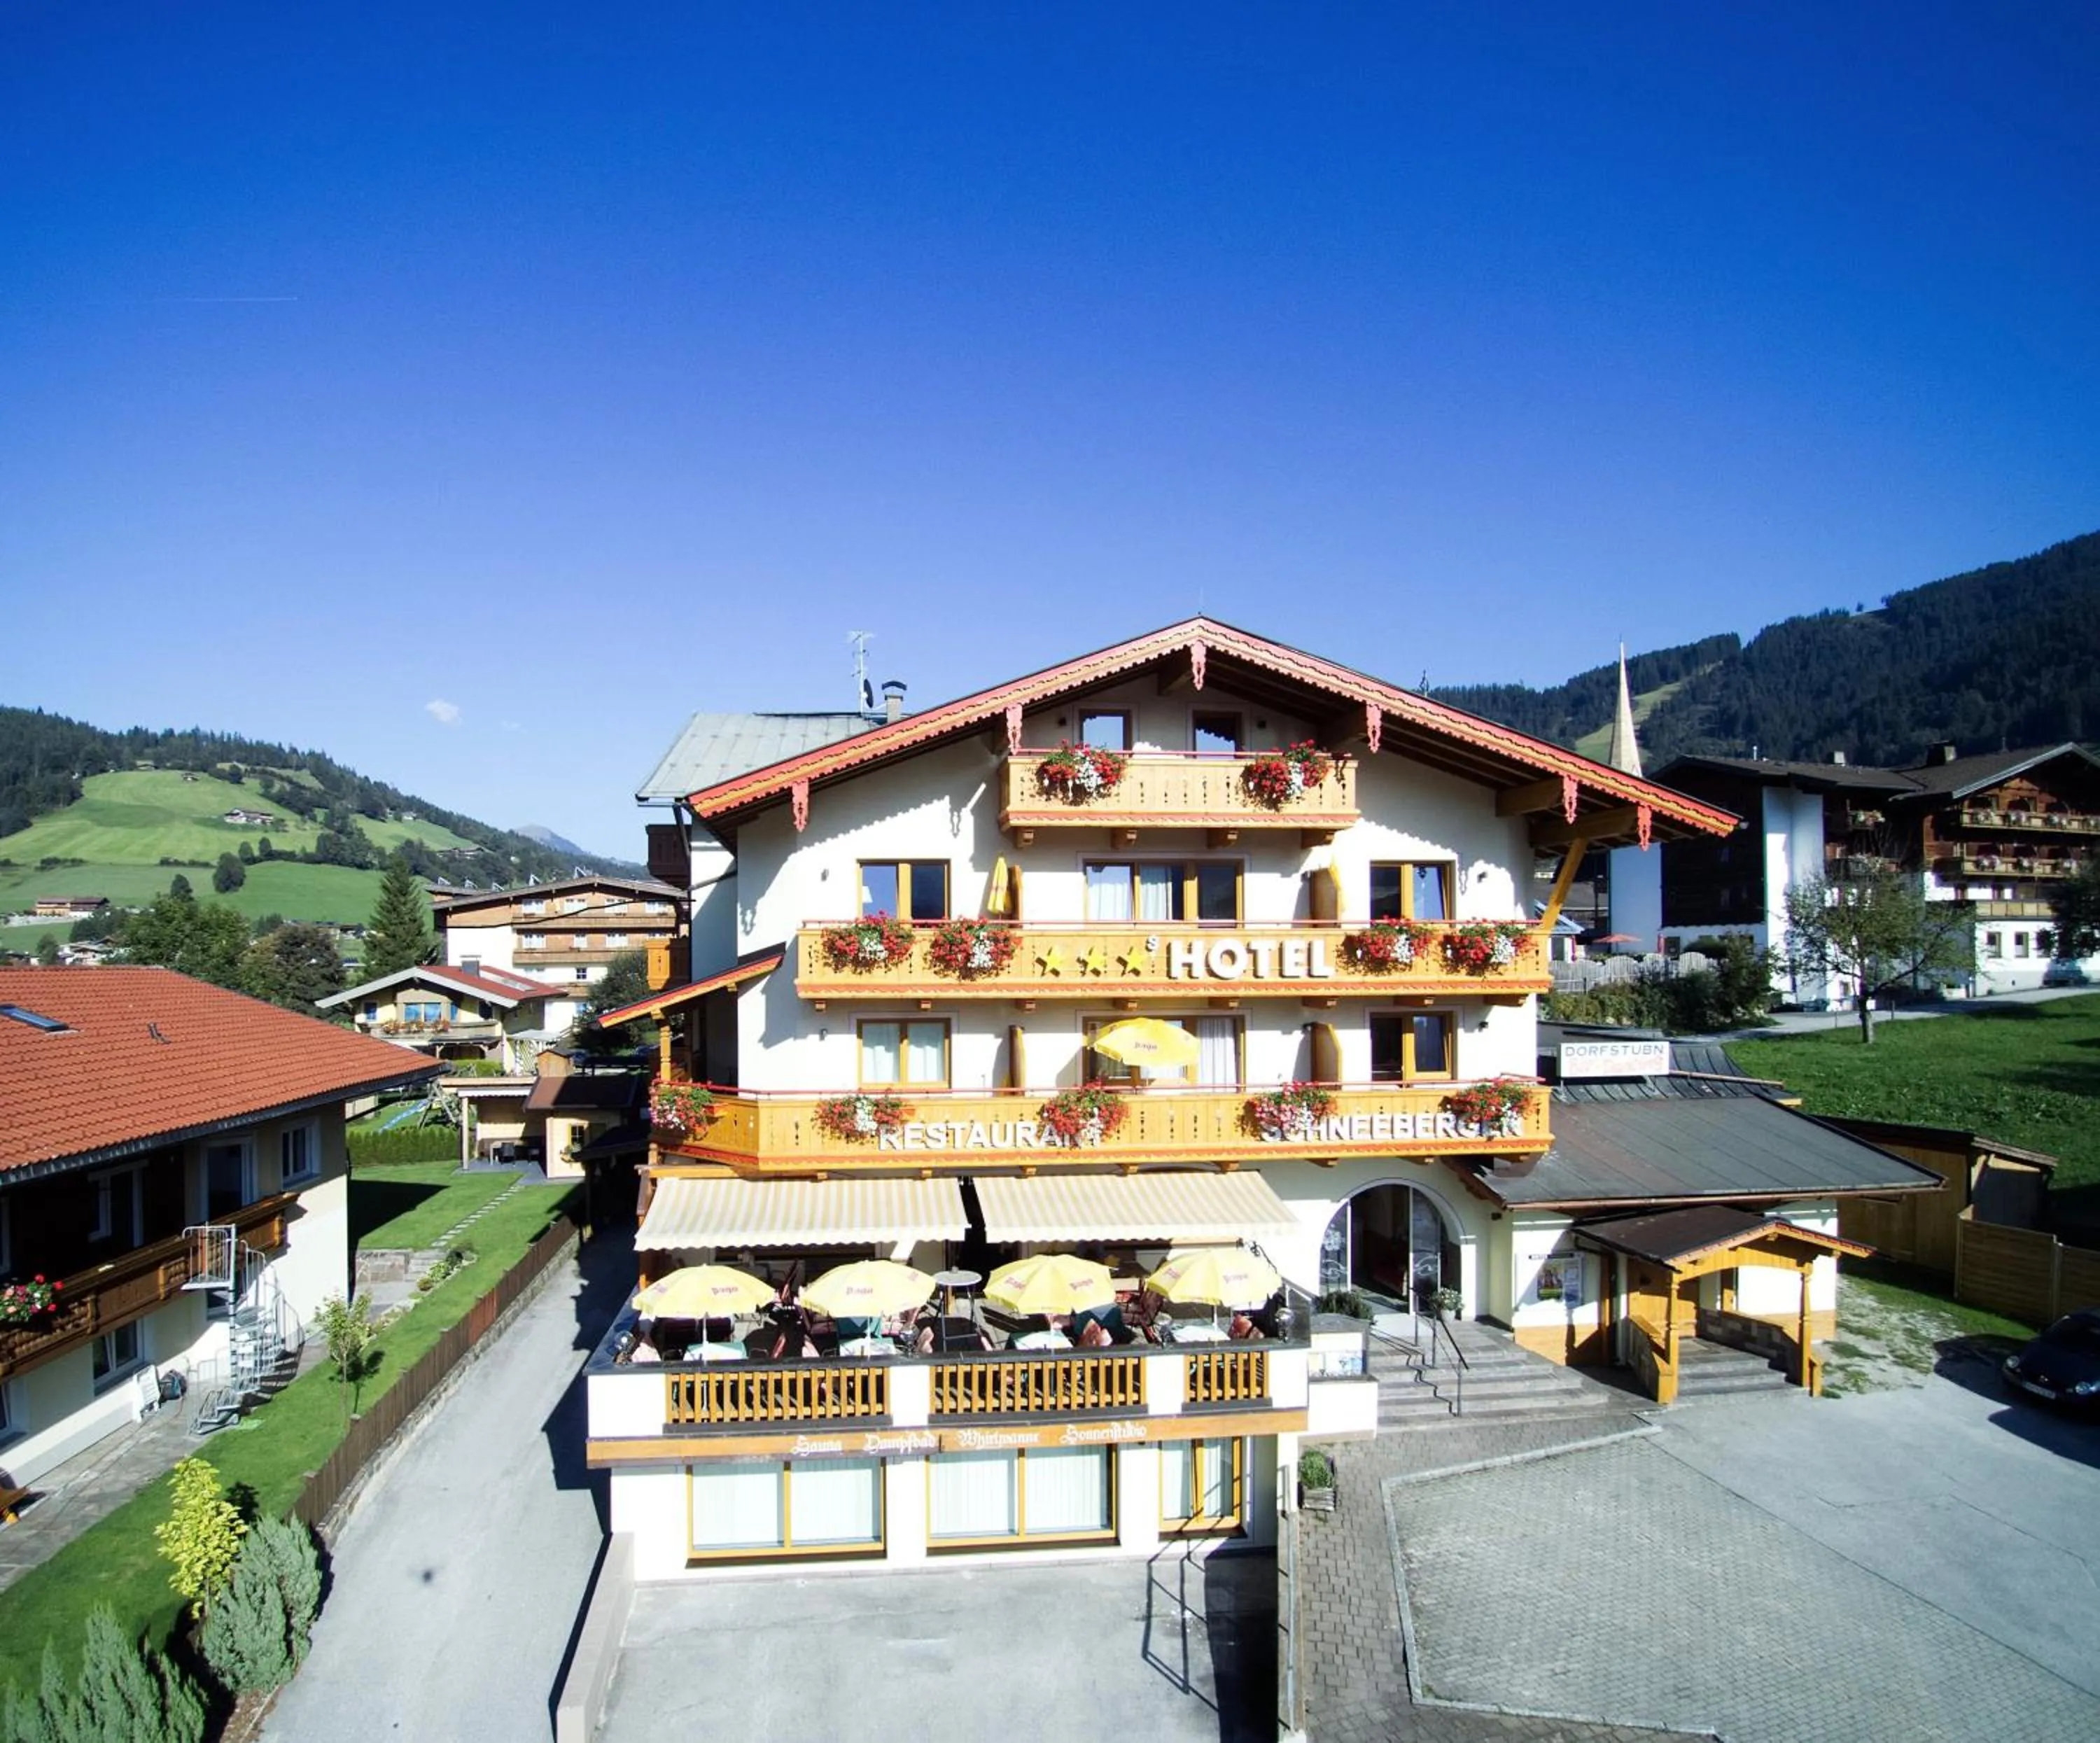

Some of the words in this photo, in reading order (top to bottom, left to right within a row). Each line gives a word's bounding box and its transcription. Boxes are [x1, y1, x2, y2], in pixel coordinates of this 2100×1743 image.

[1168, 938, 1334, 979] HOTEL
[1564, 1044, 1665, 1057] DORFSTUBN
[790, 1435, 843, 1456] Sauna
[863, 1429, 937, 1454] Dampfbad
